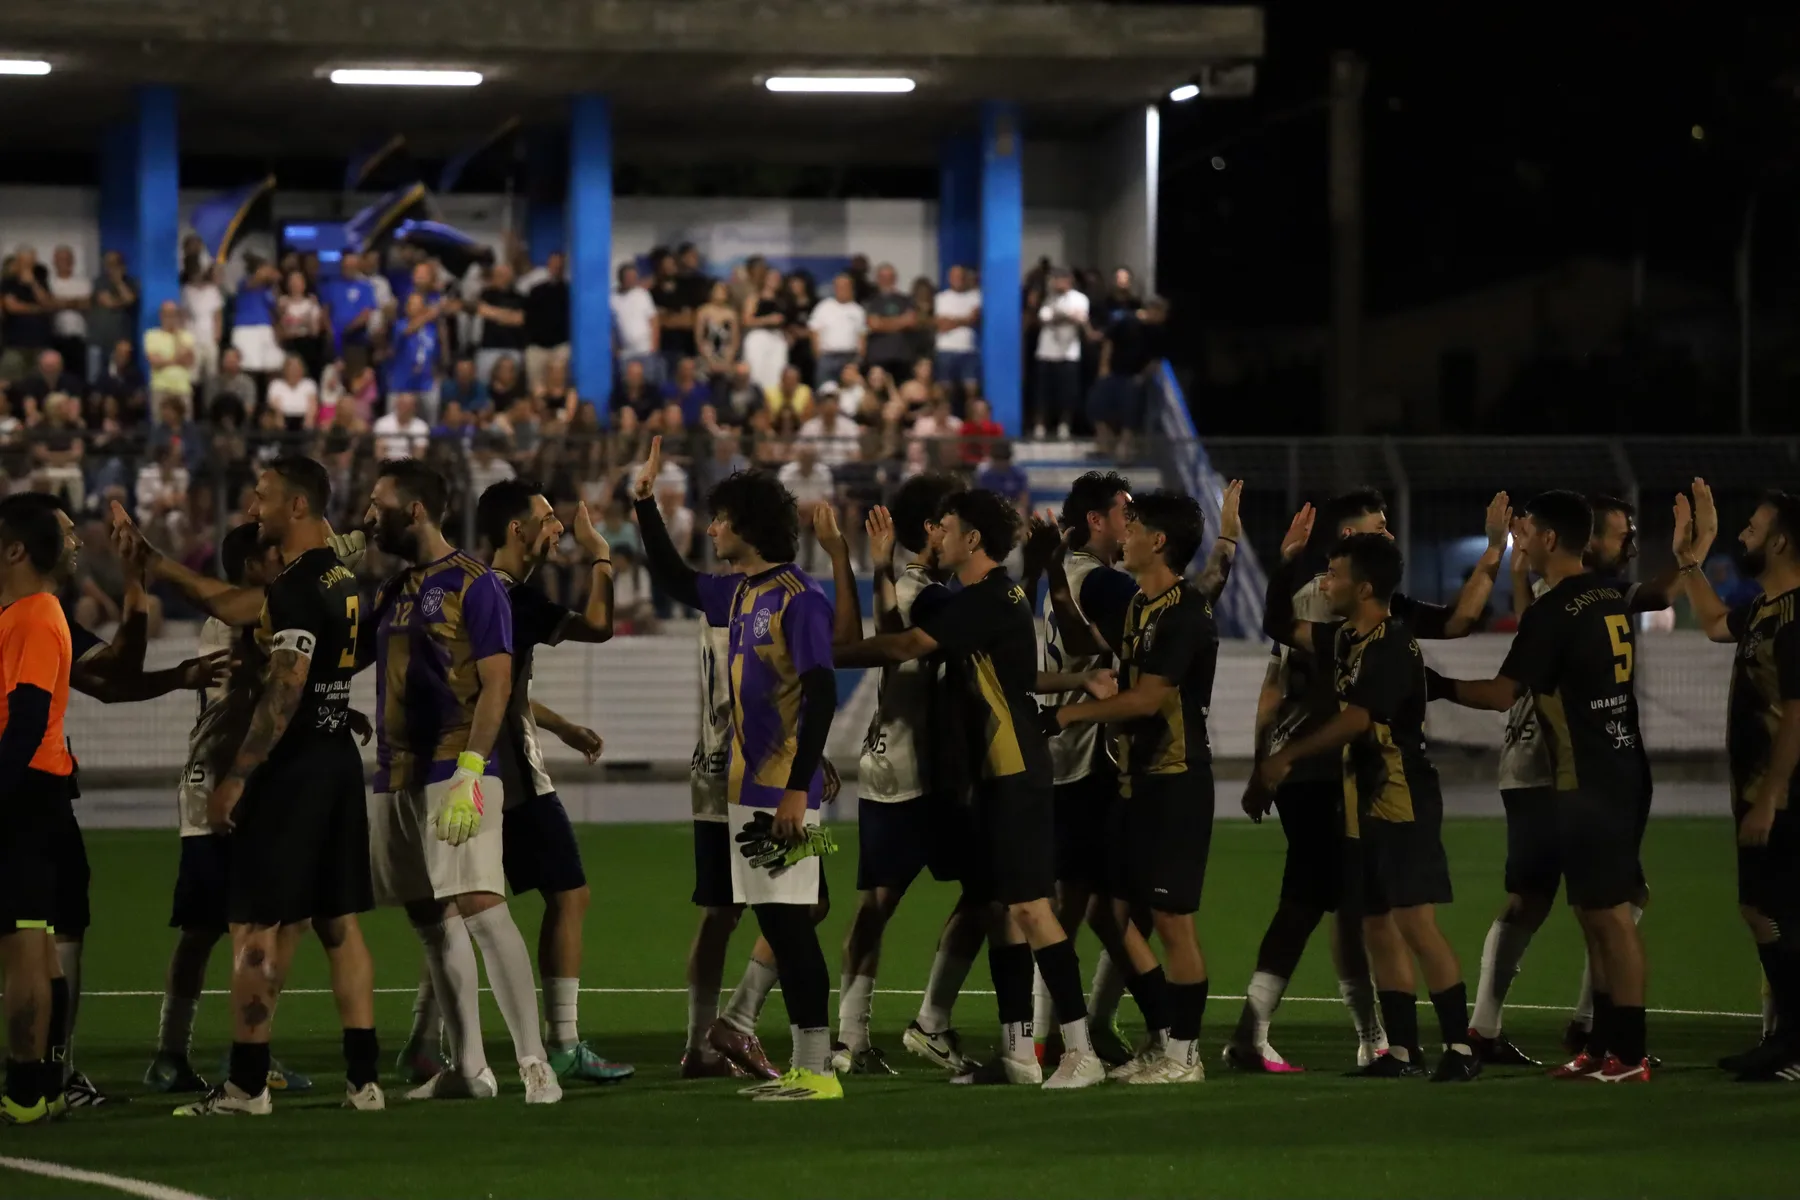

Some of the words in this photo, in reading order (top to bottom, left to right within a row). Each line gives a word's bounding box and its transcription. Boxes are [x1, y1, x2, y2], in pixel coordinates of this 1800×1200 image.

[338, 595, 359, 669] 3
[389, 601, 414, 627] 12
[296, 635, 312, 654] C
[1604, 614, 1633, 684] 5
